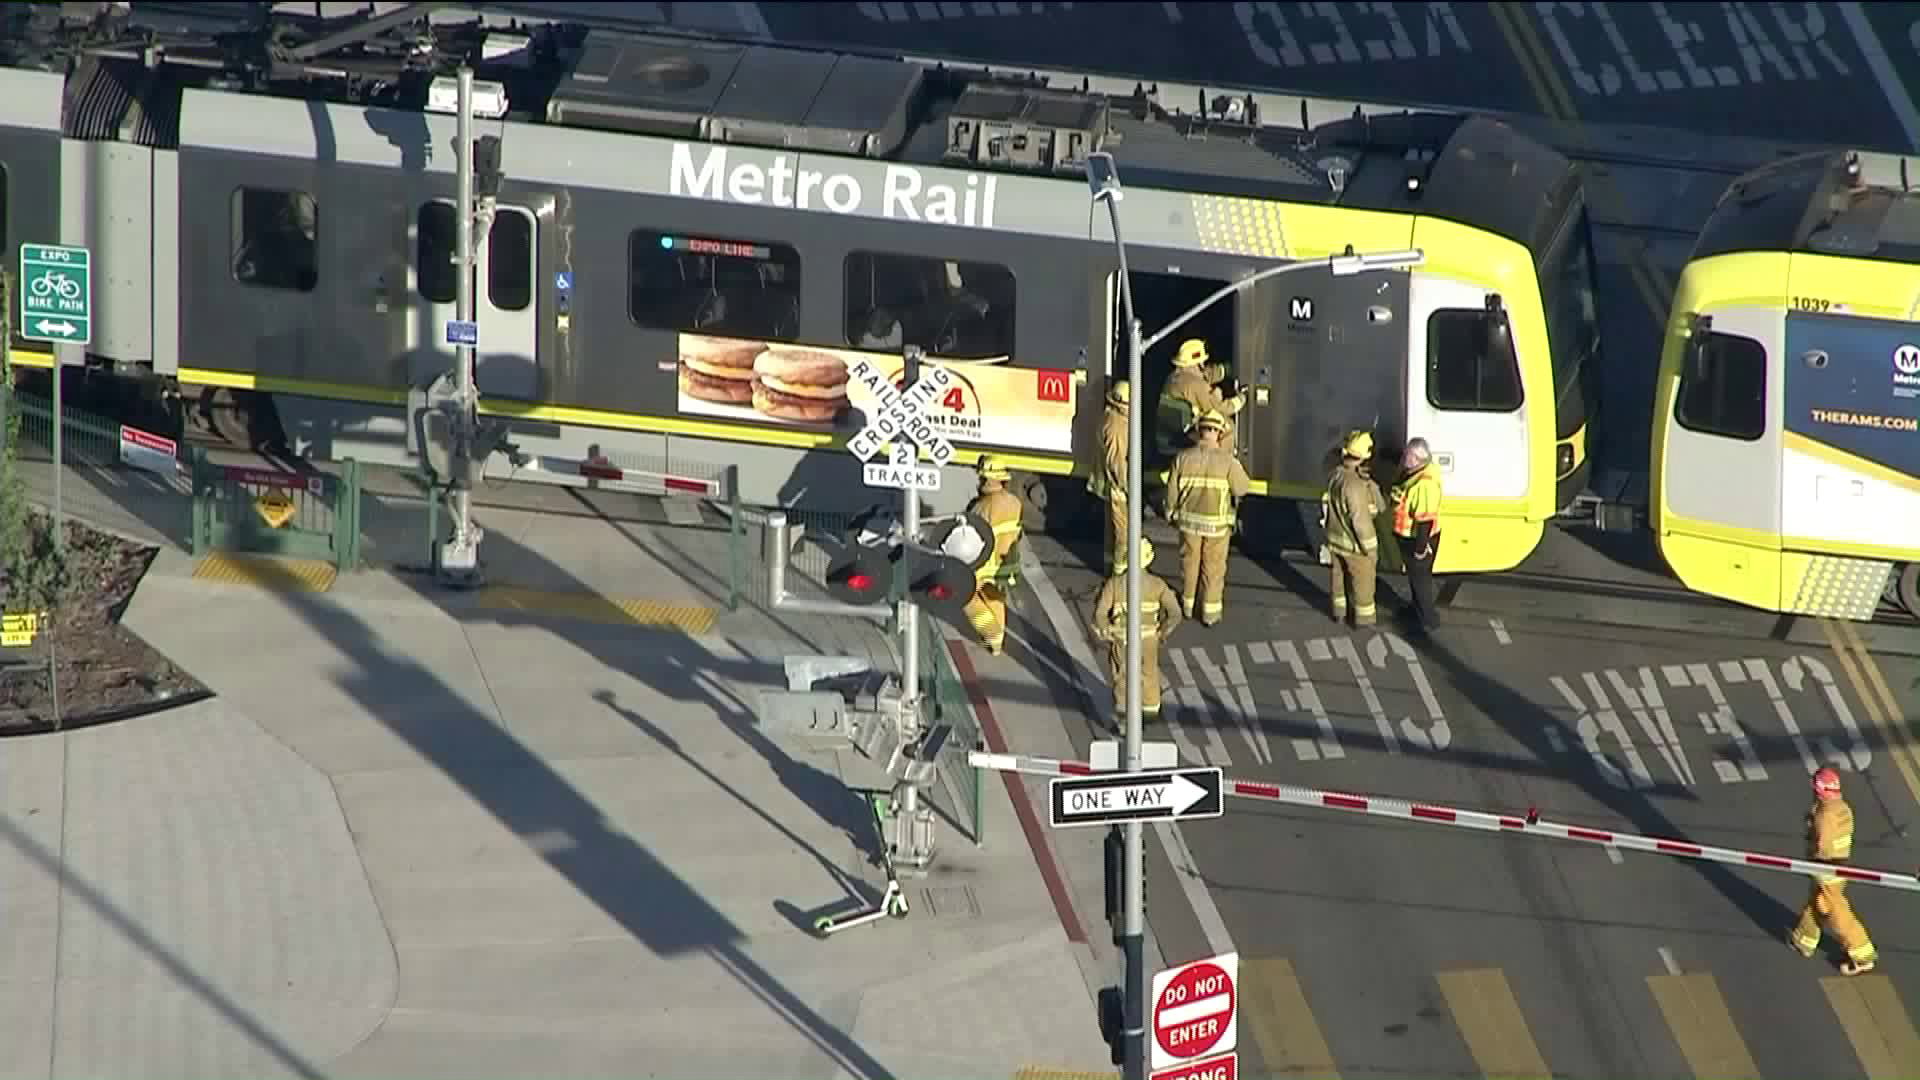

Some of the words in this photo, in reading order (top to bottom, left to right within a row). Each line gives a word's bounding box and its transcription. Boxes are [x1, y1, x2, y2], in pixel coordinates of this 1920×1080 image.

[1536, 2, 1854, 95] CLEAR
[669, 143, 862, 213] Metro
[882, 163, 997, 228] Rail
[40, 250, 70, 261] EXPO
[27, 295, 53, 310] BIKE
[58, 299, 84, 313] PATH
[1793, 296, 1830, 313] 1039
[854, 369, 949, 455] CROSSING
[936, 387, 966, 413] 4
[950, 415, 981, 429] Deal
[1811, 409, 1918, 432] THERAMS.COM
[896, 447, 908, 465] 2
[867, 467, 937, 486] TRACKS
[1158, 632, 1451, 767] CLEAR
[1550, 656, 1872, 790] CLEAR
[1072, 790, 1112, 811] ONE
[1124, 786, 1166, 806] WAY
[1165, 984, 1187, 1006] DO
[1194, 974, 1225, 998] NOT
[1169, 1018, 1218, 1048] ENTER
